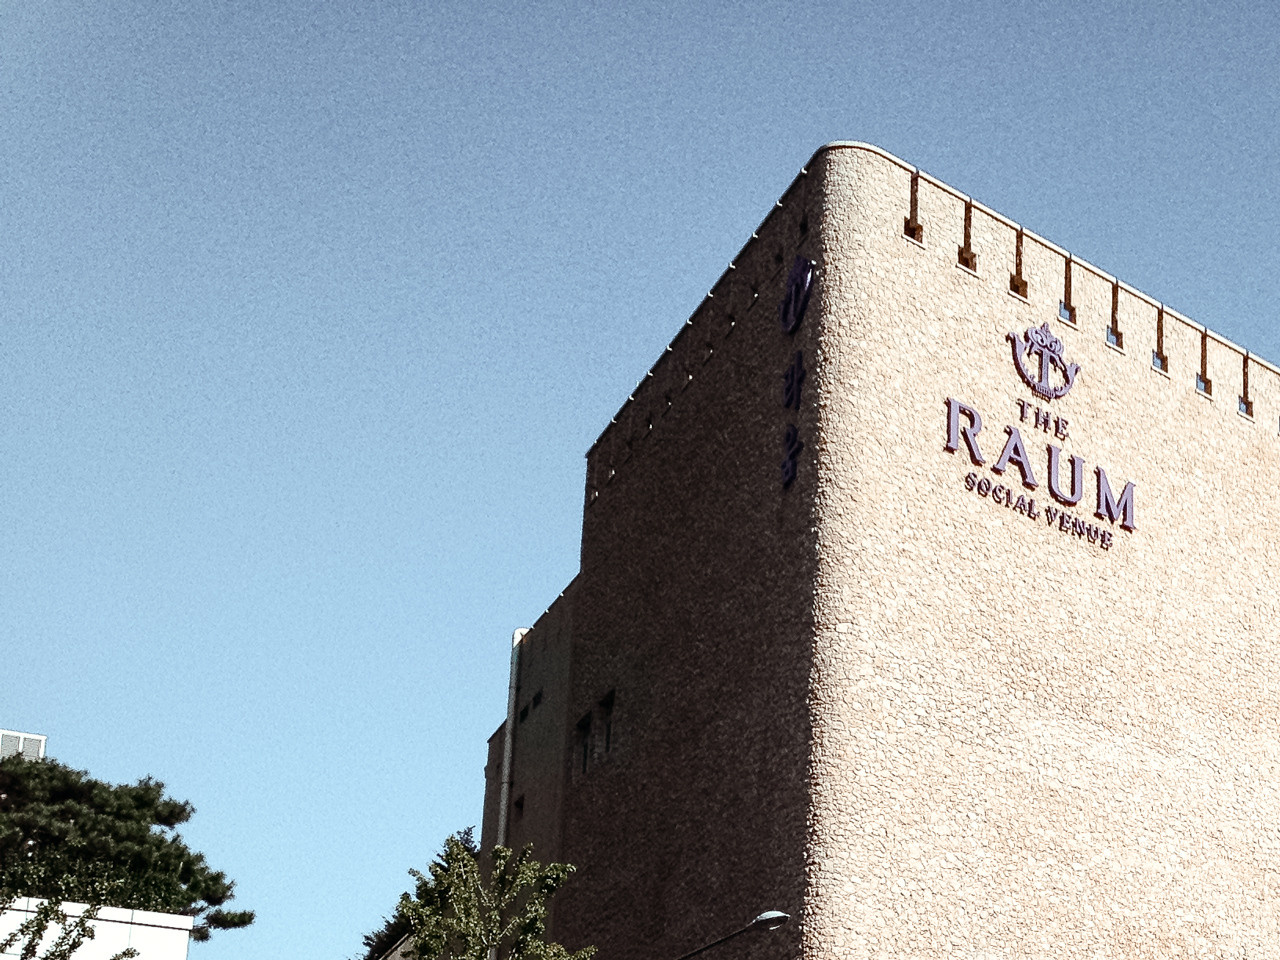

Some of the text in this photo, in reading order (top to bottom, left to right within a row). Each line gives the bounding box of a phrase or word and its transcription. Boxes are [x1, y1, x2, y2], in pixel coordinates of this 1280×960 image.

[1016, 398, 1069, 441] THE
[943, 397, 1137, 534] RAUM
[964, 472, 1113, 550] SOCIAL VENUE
